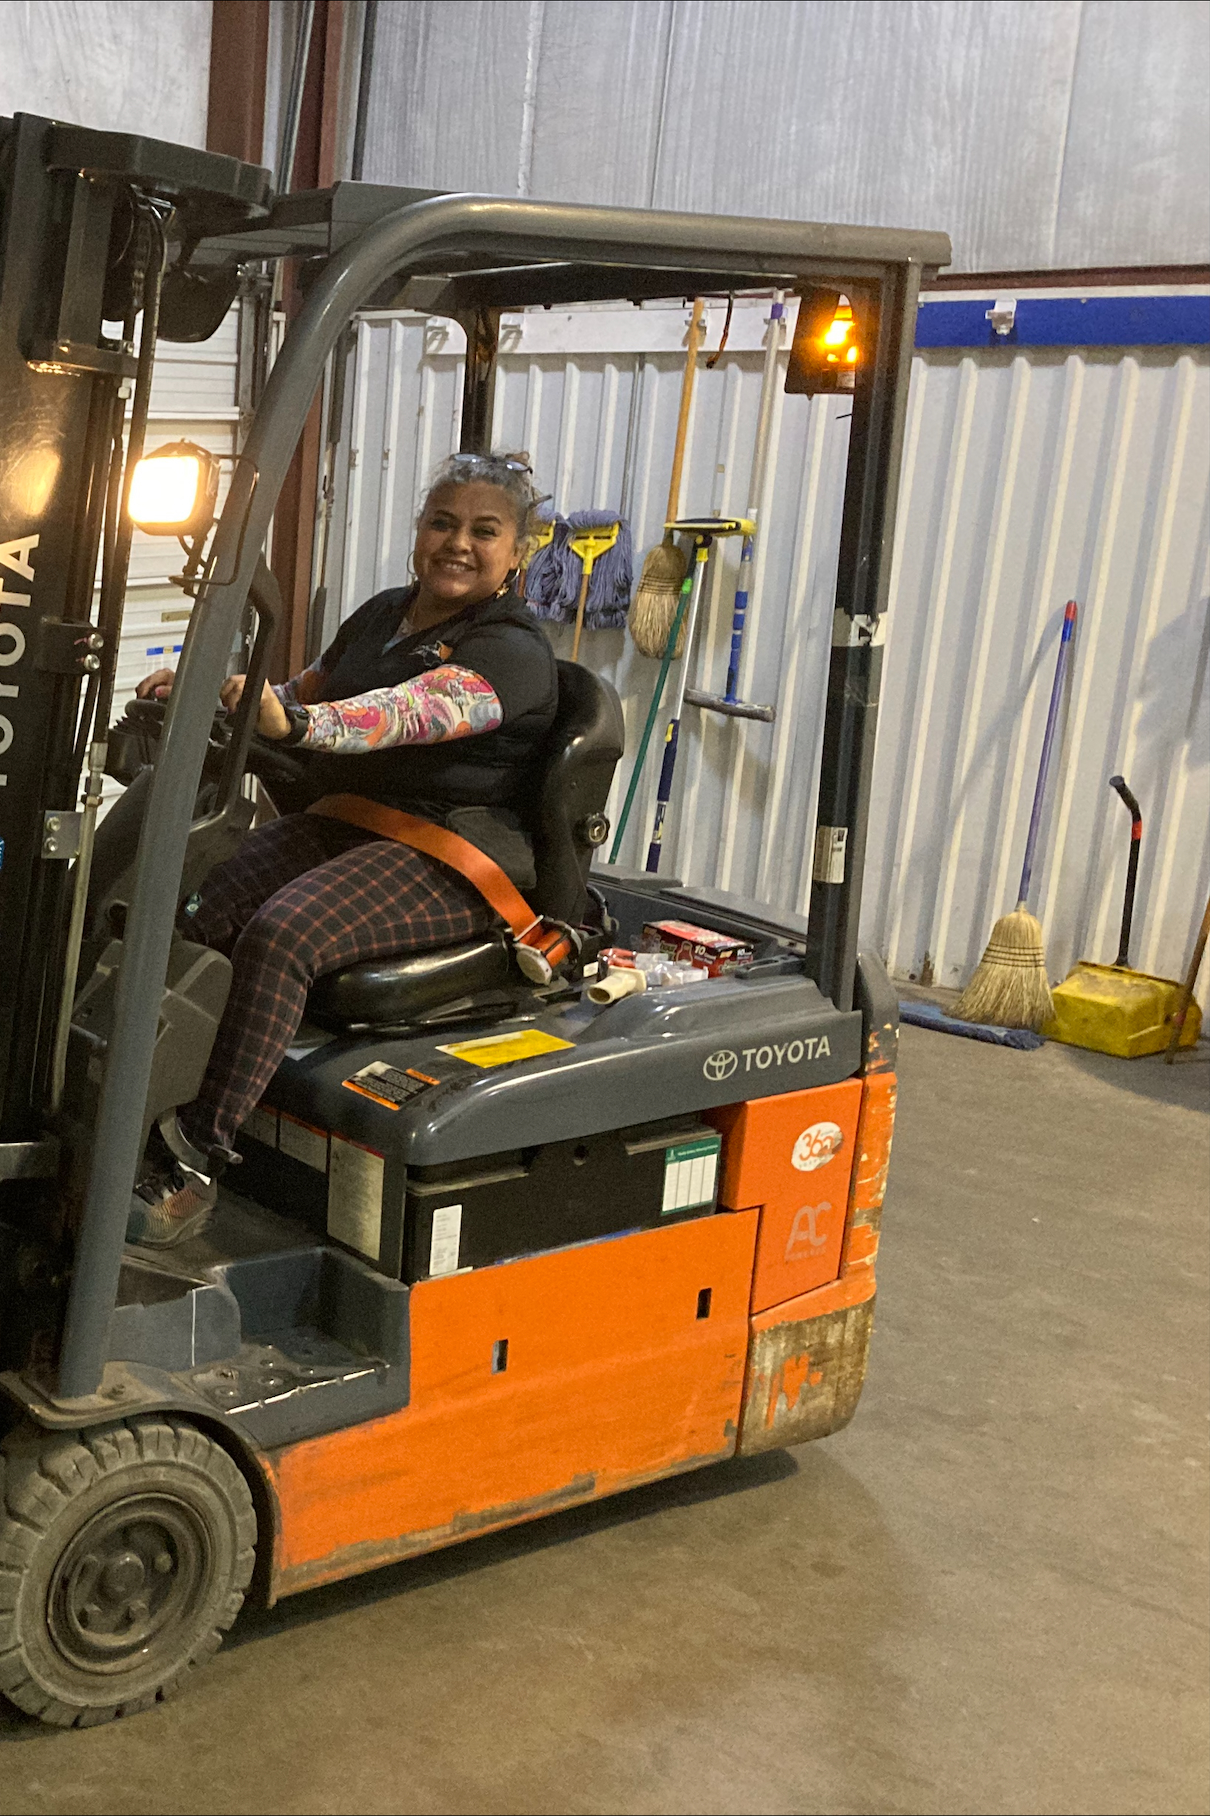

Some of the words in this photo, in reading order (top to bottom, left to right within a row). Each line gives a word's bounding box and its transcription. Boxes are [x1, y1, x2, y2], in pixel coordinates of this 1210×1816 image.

[694, 944, 706, 956] 10
[742, 1035, 831, 1072] TOYOTA
[785, 1201, 833, 1254] AC
